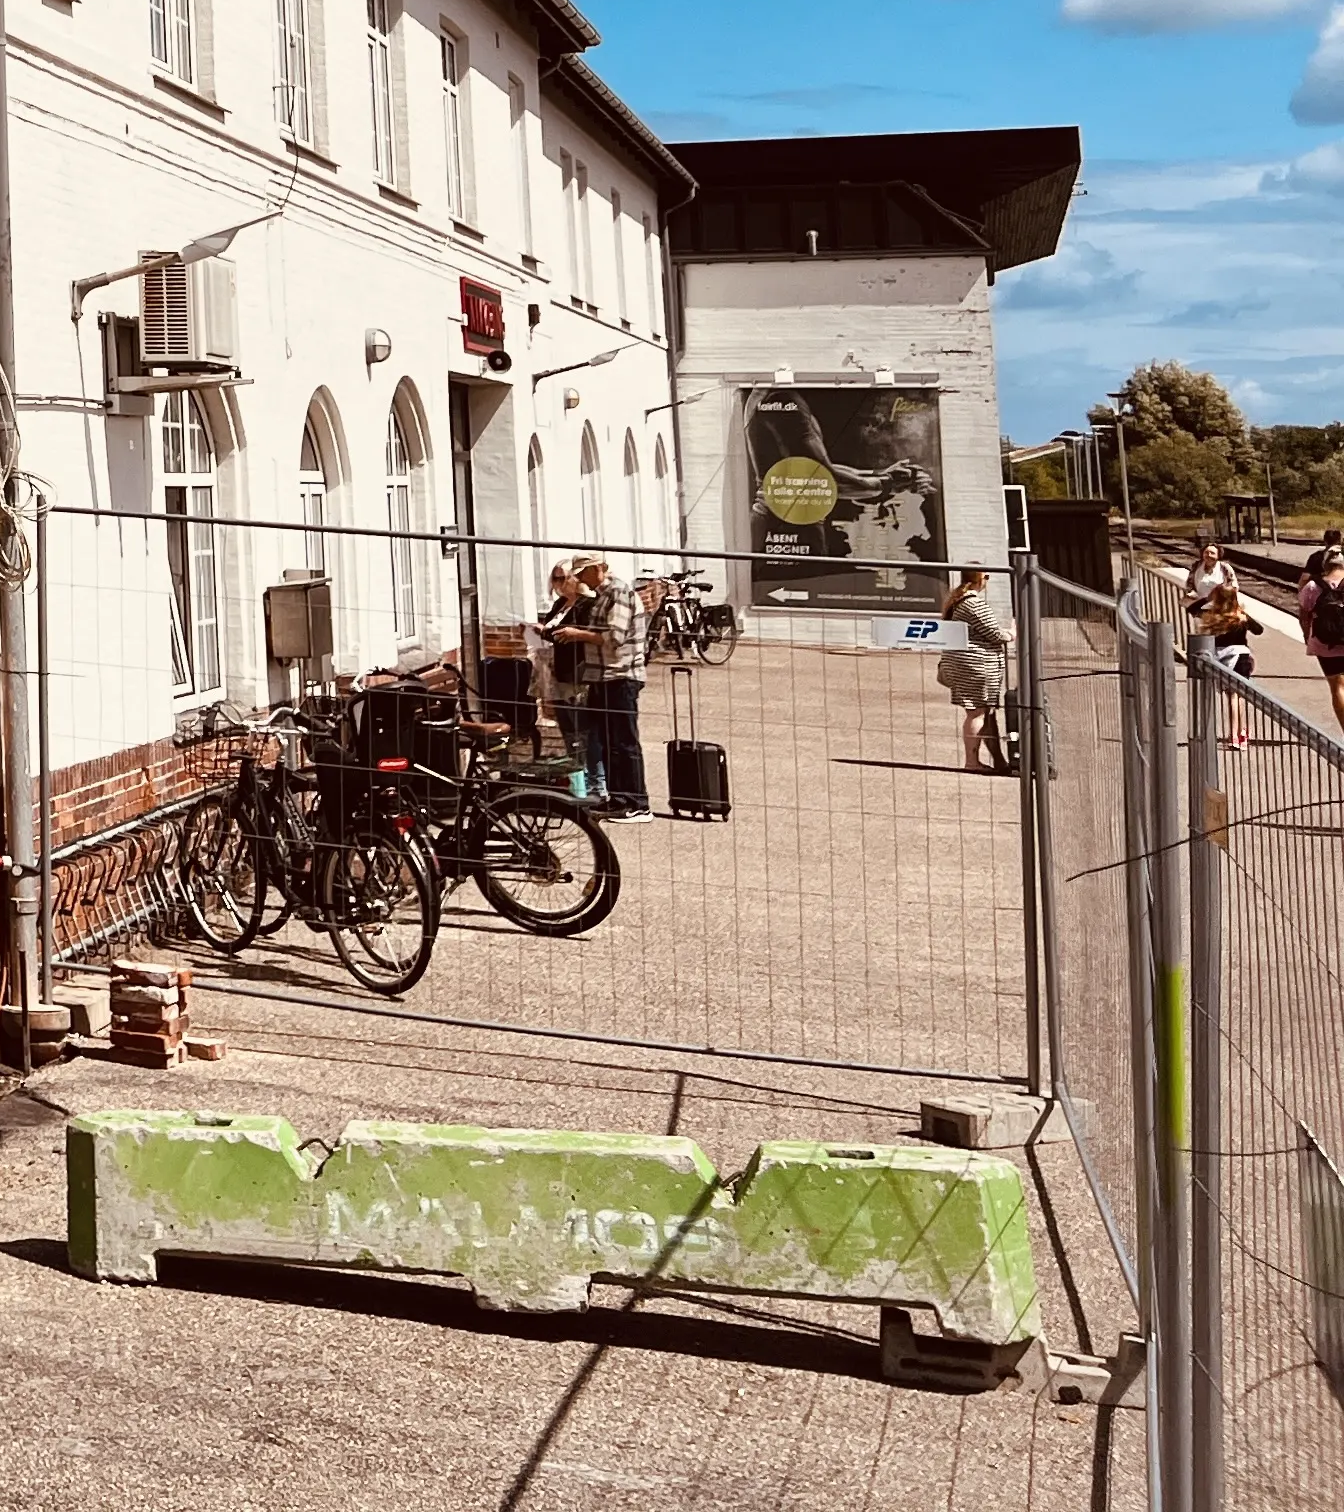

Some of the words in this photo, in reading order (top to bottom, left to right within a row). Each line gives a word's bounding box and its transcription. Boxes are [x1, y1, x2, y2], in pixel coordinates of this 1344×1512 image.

[765, 531, 799, 543] ÅBENT
[766, 544, 810, 555] DØGNET
[905, 620, 939, 639] EP
